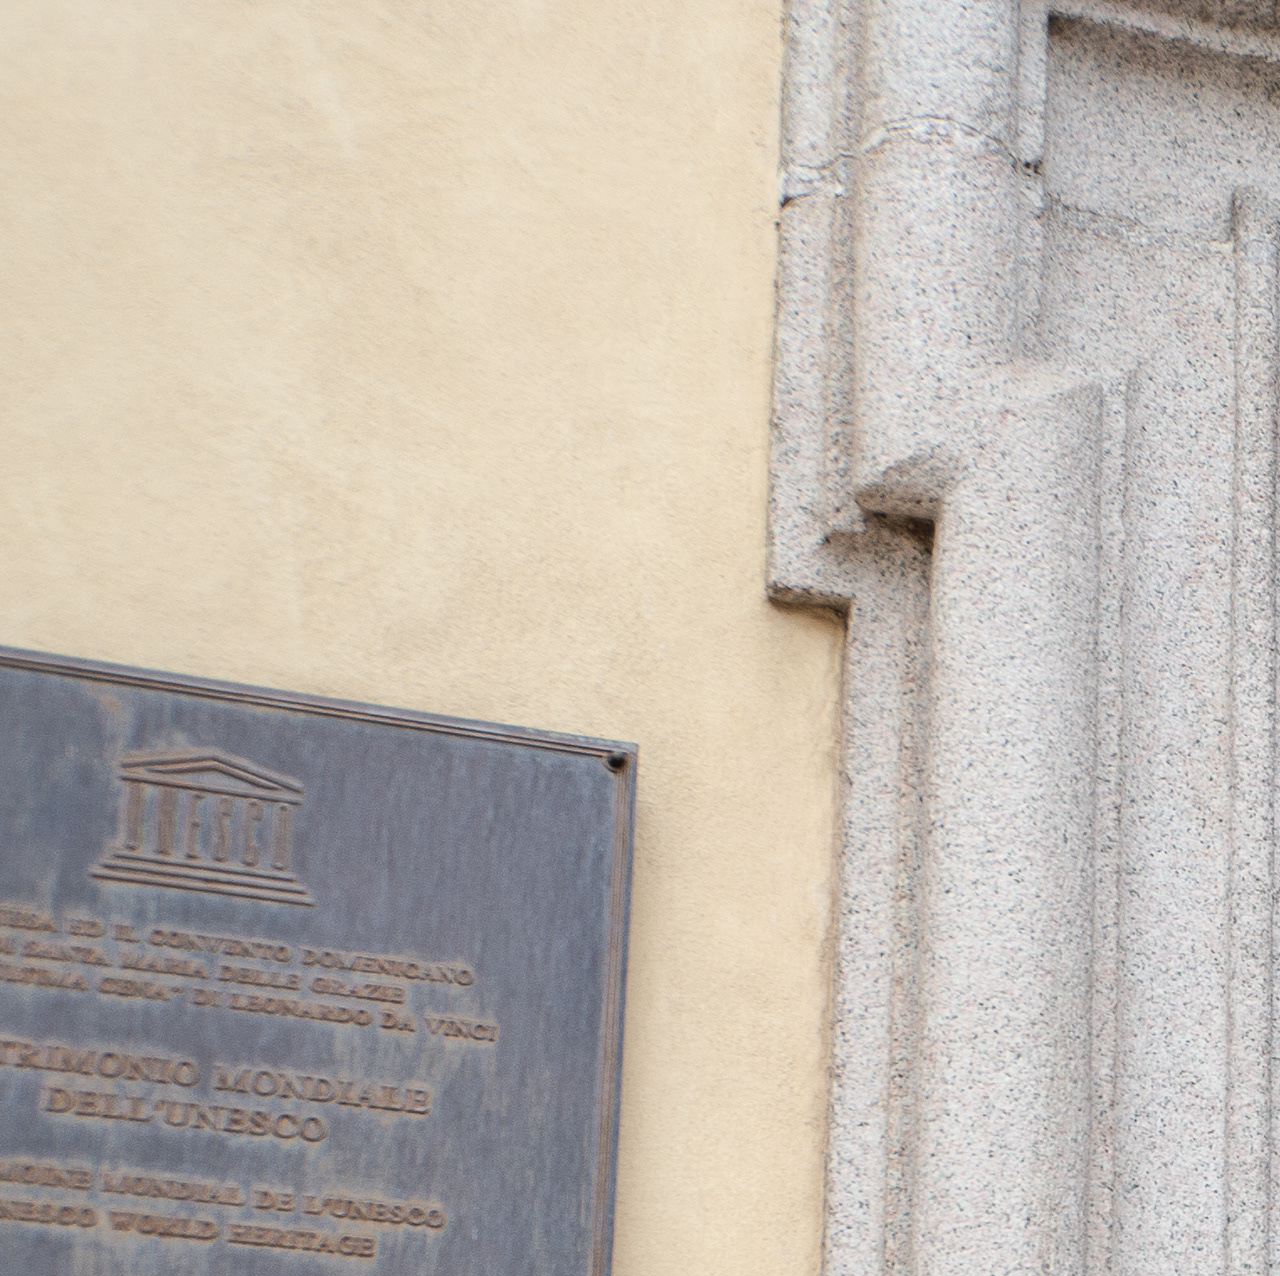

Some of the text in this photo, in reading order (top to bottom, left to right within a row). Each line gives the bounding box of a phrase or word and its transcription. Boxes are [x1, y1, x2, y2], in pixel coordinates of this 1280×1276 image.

[148, 927, 294, 963] CONVENTO
[300, 945, 476, 988] DOMENICANO
[216, 963, 301, 991] DELLE
[310, 977, 406, 1005] GRAZIE
[226, 992, 373, 1028] LEONARDO
[378, 1008, 418, 1034] DA
[423, 1014, 499, 1043] VINCI
[43, 1086, 329, 1142] DELL'UNESCO
[210, 1066, 433, 1115] MONDIALE
[100, 1168, 446, 1229] MONDIAL DE L'UNESCO
[105, 1209, 219, 1241] WORLD
[226, 1223, 378, 1258] HERITAGE
